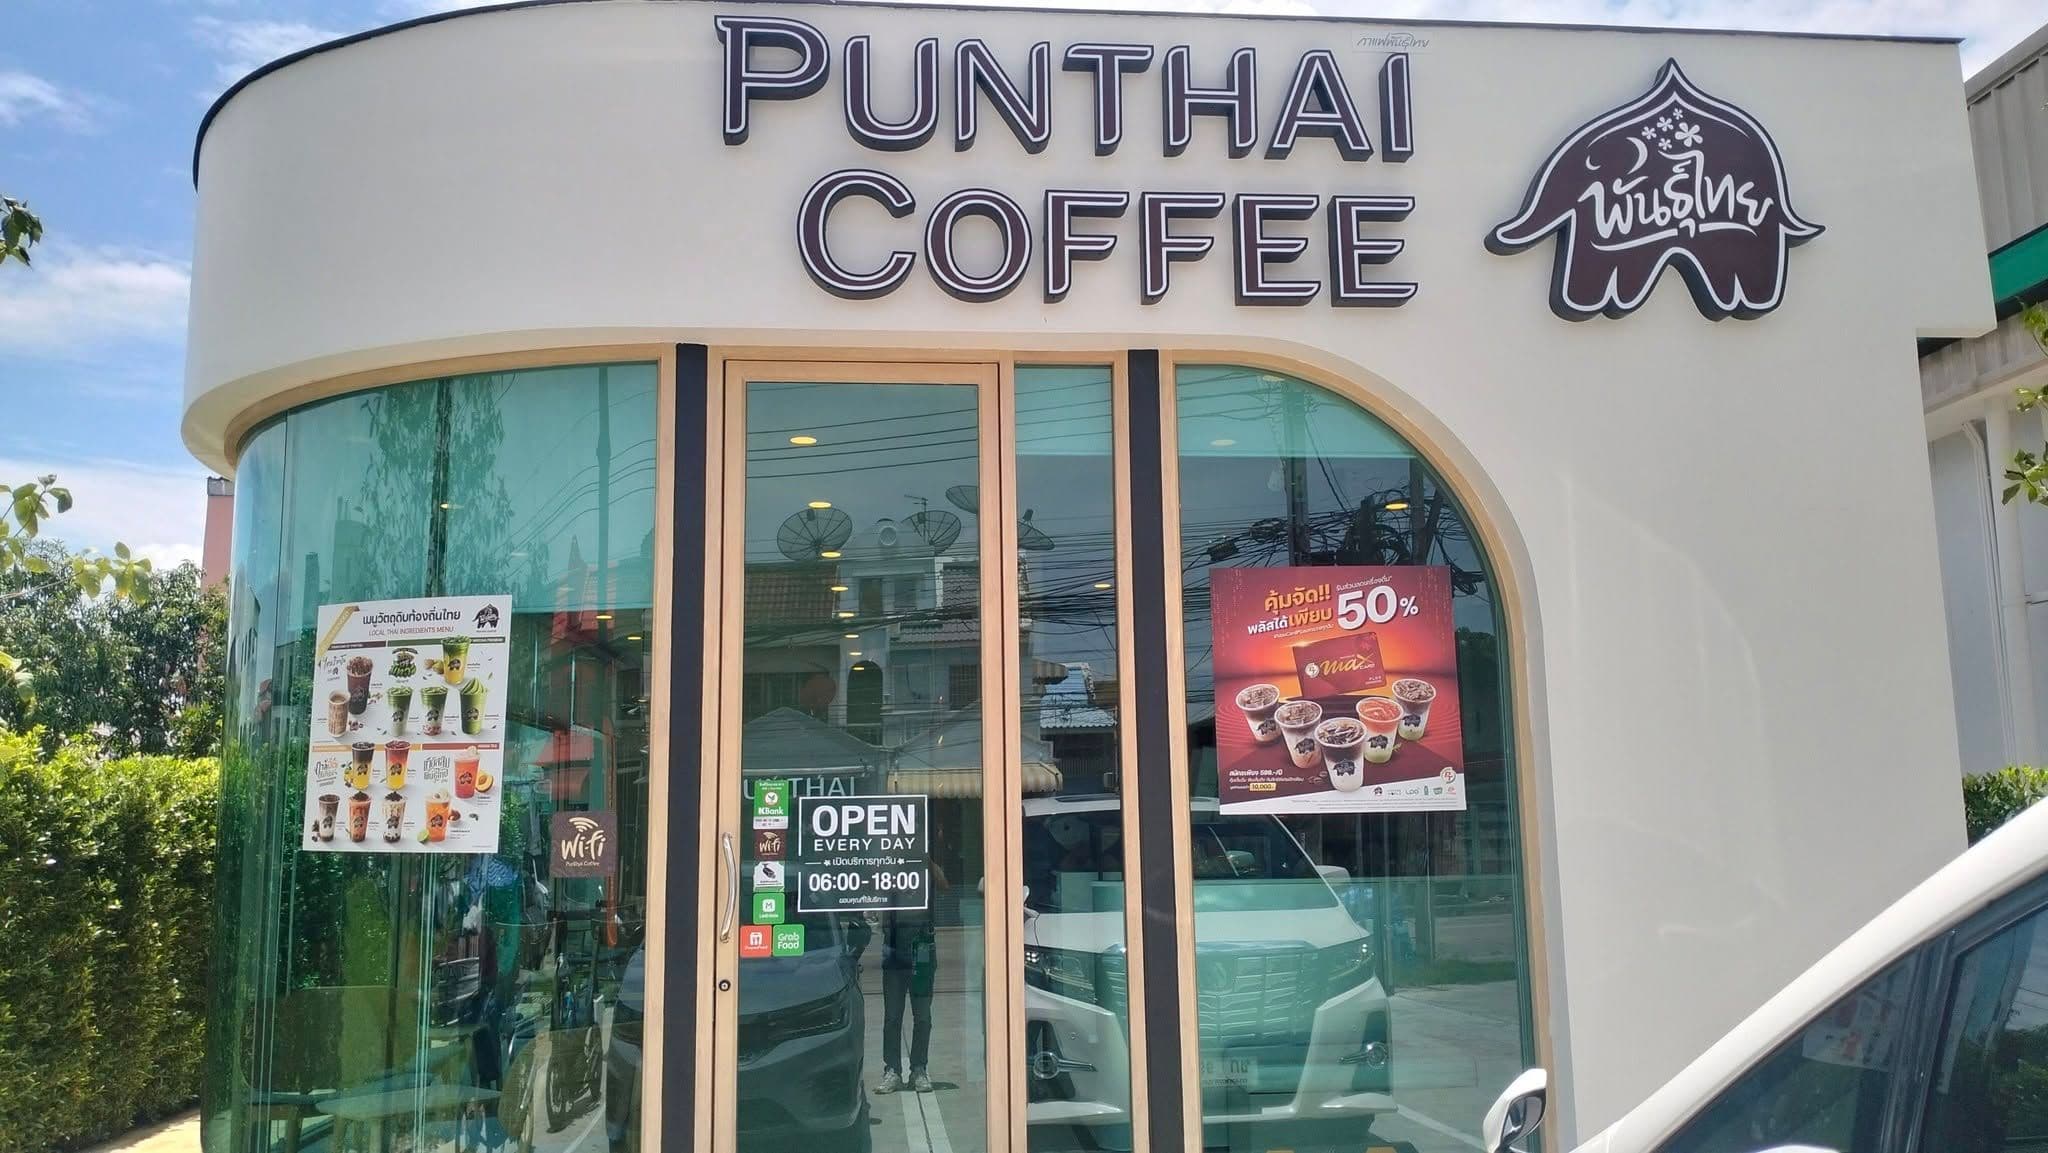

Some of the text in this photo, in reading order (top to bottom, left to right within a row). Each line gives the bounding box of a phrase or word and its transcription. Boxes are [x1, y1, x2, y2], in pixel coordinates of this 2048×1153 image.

[714, 14, 1414, 162] PUNTHAI
[1577, 150, 1774, 239] พันธุ์ไทย
[796, 168, 1418, 307] COFFEE
[1264, 583, 1332, 615] คุ้มจัด!!
[363, 606, 461, 628] เมนูวัตถุดิบท้องถิ่นไทย
[436, 625, 454, 633] MENU
[758, 806, 785, 816] KBank
[812, 803, 916, 837] OPEN
[814, 837, 916, 852] EVERY DAY
[832, 855, 897, 868] เปิดบริการทุกวัน
[777, 932, 800, 942] Grab
[777, 940, 800, 950] Food
